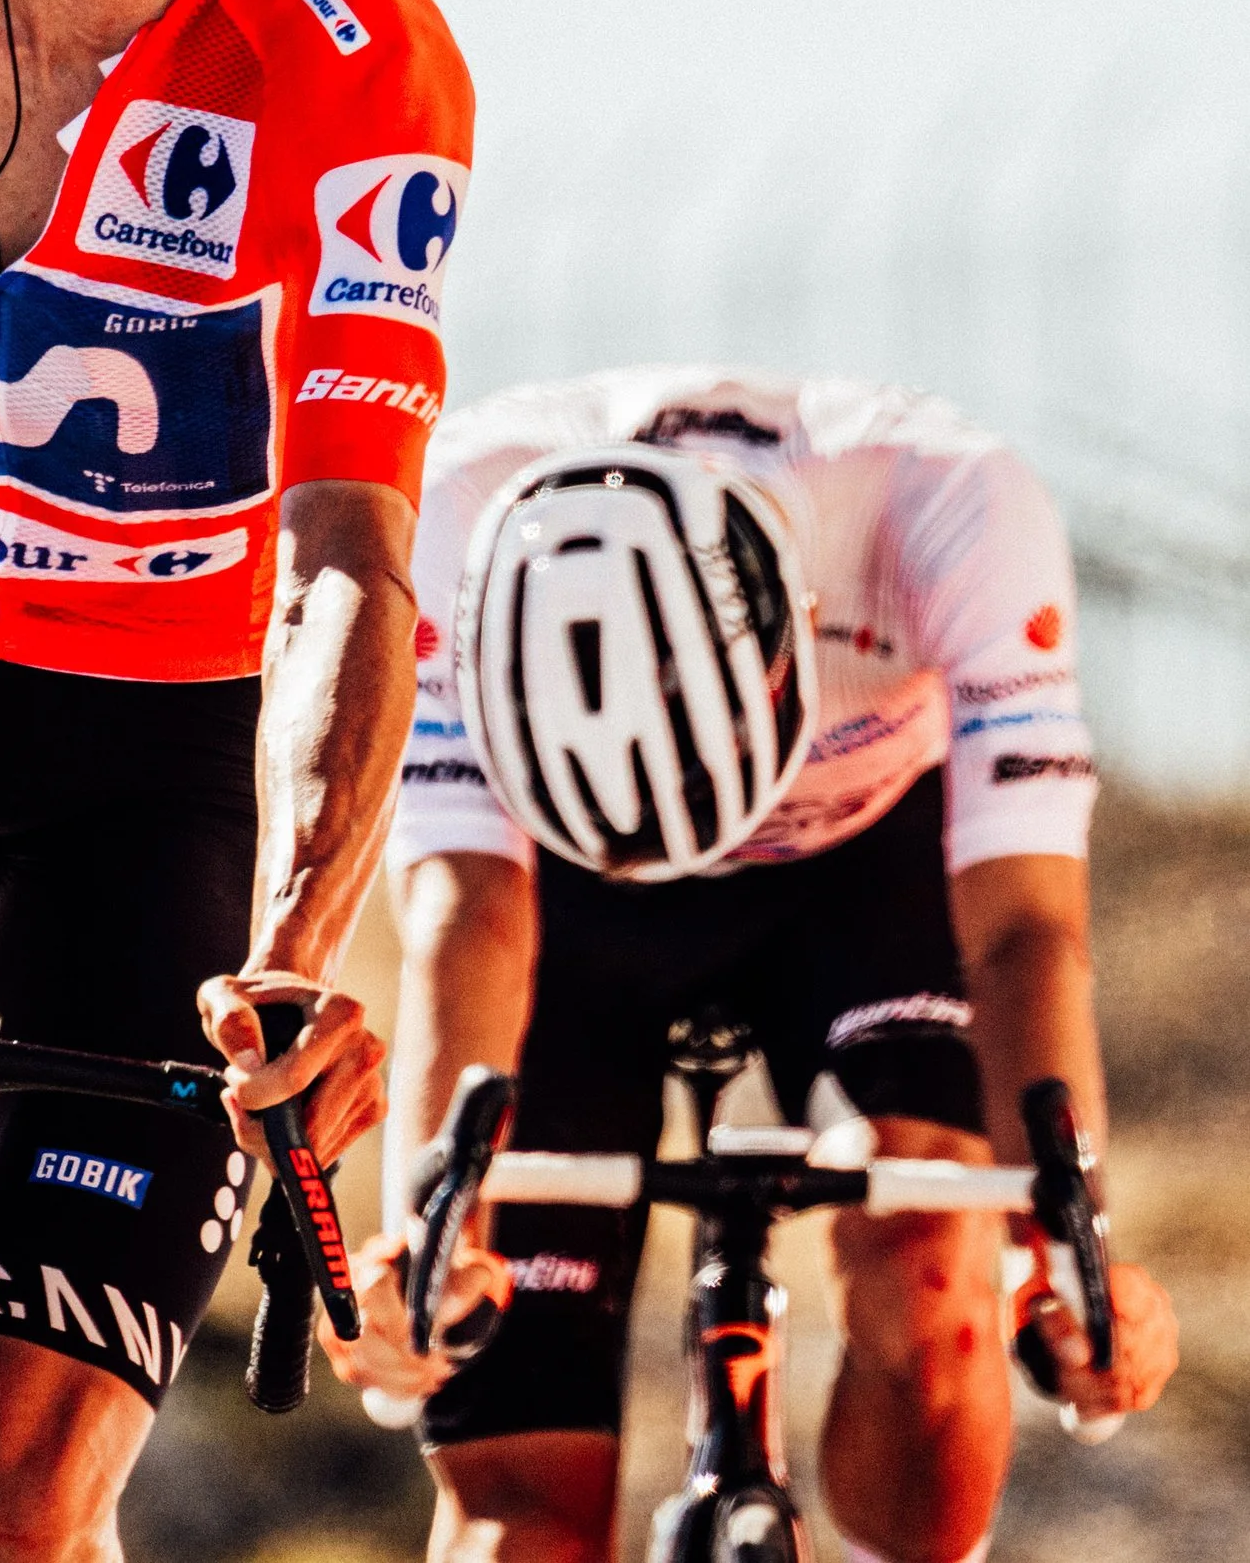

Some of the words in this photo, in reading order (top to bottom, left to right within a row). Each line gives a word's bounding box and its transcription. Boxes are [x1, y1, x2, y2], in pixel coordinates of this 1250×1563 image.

[94, 212, 235, 265] Carrefour
[35, 1151, 145, 1202] GOBIK
[288, 1146, 352, 1290] SRAM
